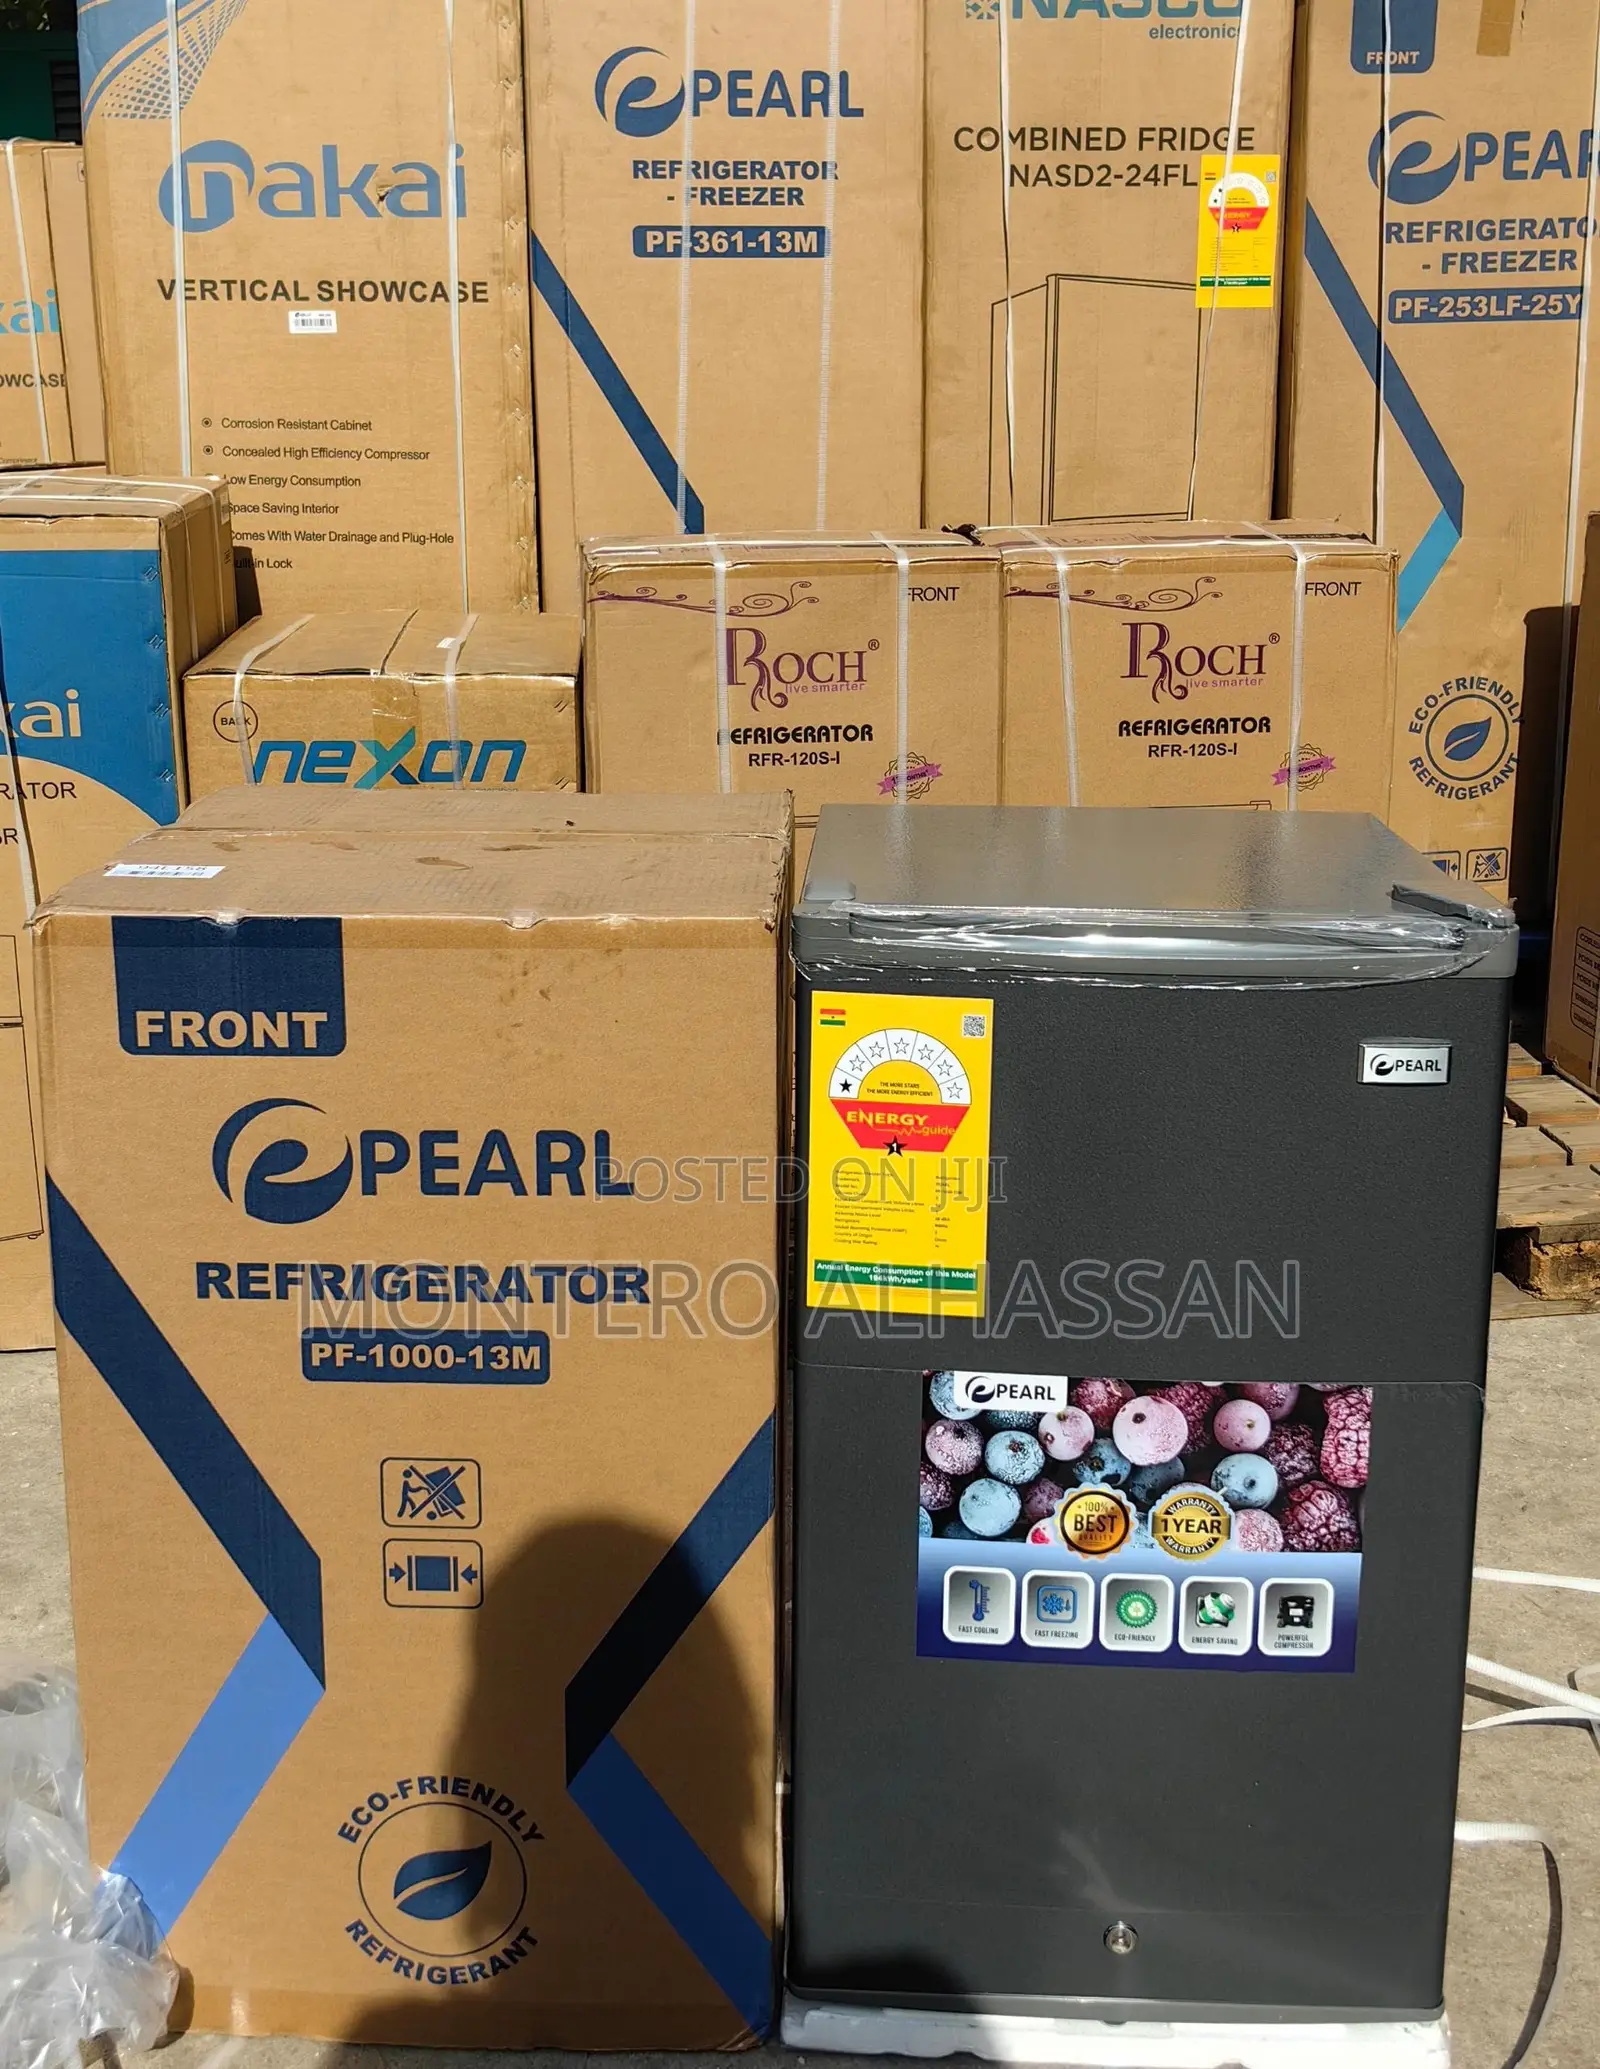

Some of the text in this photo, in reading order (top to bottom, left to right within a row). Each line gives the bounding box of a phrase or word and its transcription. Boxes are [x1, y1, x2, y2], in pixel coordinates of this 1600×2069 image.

[692, 69, 864, 117] PEARL
[954, 126, 1255, 152] COMBINED FRIDGE
[633, 160, 839, 180] REFRIGERATOR
[1009, 163, 1198, 187] NASD2-24FL
[689, 187, 804, 206] FREEZER
[646, 229, 818, 254] PF-361-13M
[1441, 250, 1577, 274] FREEZER
[157, 279, 489, 303] VERTICAL SHOWCASE
[1394, 293, 1583, 319] PF-253LF-25Y
[221, 417, 372, 431] Corrosion Resistant Cabinet
[222, 446, 430, 462] Concealed High Efficiency Compressor
[249, 475, 288, 488] Energy
[290, 475, 361, 488] Consumption
[262, 503, 300, 516] Saving
[302, 504, 339, 514] Interior
[267, 531, 292, 542] With
[294, 531, 326, 542] Water
[328, 532, 377, 545] Drainage
[380, 532, 399, 543] and
[402, 532, 454, 545] Plug-Hole
[266, 558, 293, 569] Lock
[1304, 582, 1361, 596] FRONT
[785, 682, 865, 694] live smarter
[1185, 677, 1264, 689] live smarter
[1408, 676, 1525, 734] ECO-FRIENDLY
[1118, 716, 1271, 737] REFRIGERATOR
[253, 726, 527, 790] nexon
[748, 751, 840, 766] RFR-120S-I
[1148, 743, 1238, 758] RFR-120S-I
[1409, 752, 1521, 800] REFRIGERANT
[135, 1010, 328, 1048] FRONT
[1395, 1059, 1442, 1072] PEARL
[846, 1108, 928, 1127] ENERGY
[922, 1125, 956, 1137] guide
[891, 1142, 897, 1152] 1
[360, 1129, 634, 1197] PEARL
[816, 1262, 844, 1271] Annual
[845, 1263, 871, 1274] Energy
[873, 1265, 924, 1277] Consumption
[925, 1269, 933, 1277] of
[951, 1271, 976, 1279] Model
[196, 1260, 651, 1305] REFRIGERATOR
[311, 1342, 541, 1371] PF-1000-13M
[996, 1383, 1056, 1401] PEARL
[1167, 1497, 1218, 1514] WARRANTY
[1074, 1514, 1118, 1533] BEST
[1161, 1519, 1222, 1534] 1 YEAR
[1165, 1536, 1215, 1554] WARRANTY
[958, 1625, 999, 1635] FAST COOLING
[1035, 1629, 1078, 1639] FAST FREEZING
[1115, 1633, 1156, 1642] ECO-FRIENDLY
[1191, 1636, 1238, 1645] ENERGY SAVING
[1274, 1641, 1314, 1649] COMPRESSOR
[337, 1776, 545, 1843] ECO-FRIENDLY
[345, 1918, 538, 1985] REFRIGERANT
